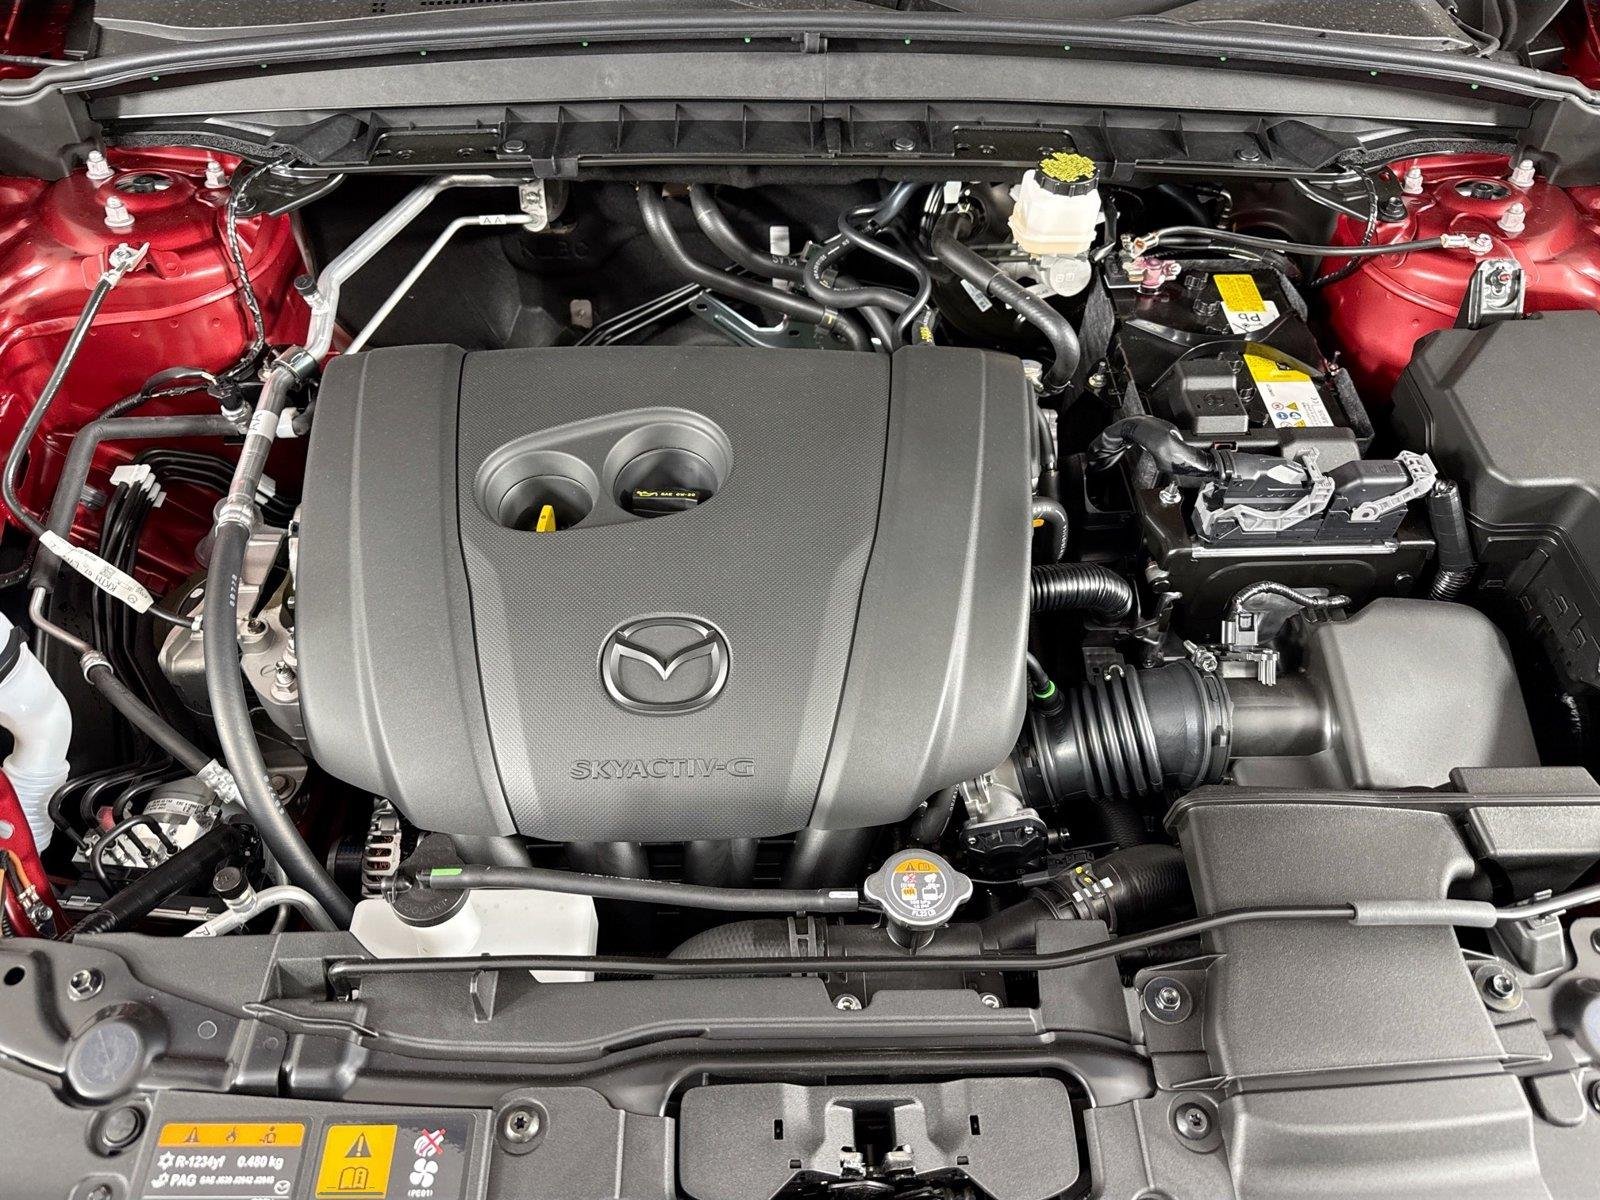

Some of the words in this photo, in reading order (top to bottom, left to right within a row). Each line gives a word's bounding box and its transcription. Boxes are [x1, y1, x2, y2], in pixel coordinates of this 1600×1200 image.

[1238, 313, 1261, 322] Pb
[569, 757, 757, 780] SKYACTIV-G
[174, 1155, 226, 1171] R-1234yf
[268, 1155, 285, 1171] kg
[170, 1173, 198, 1187] PAG
